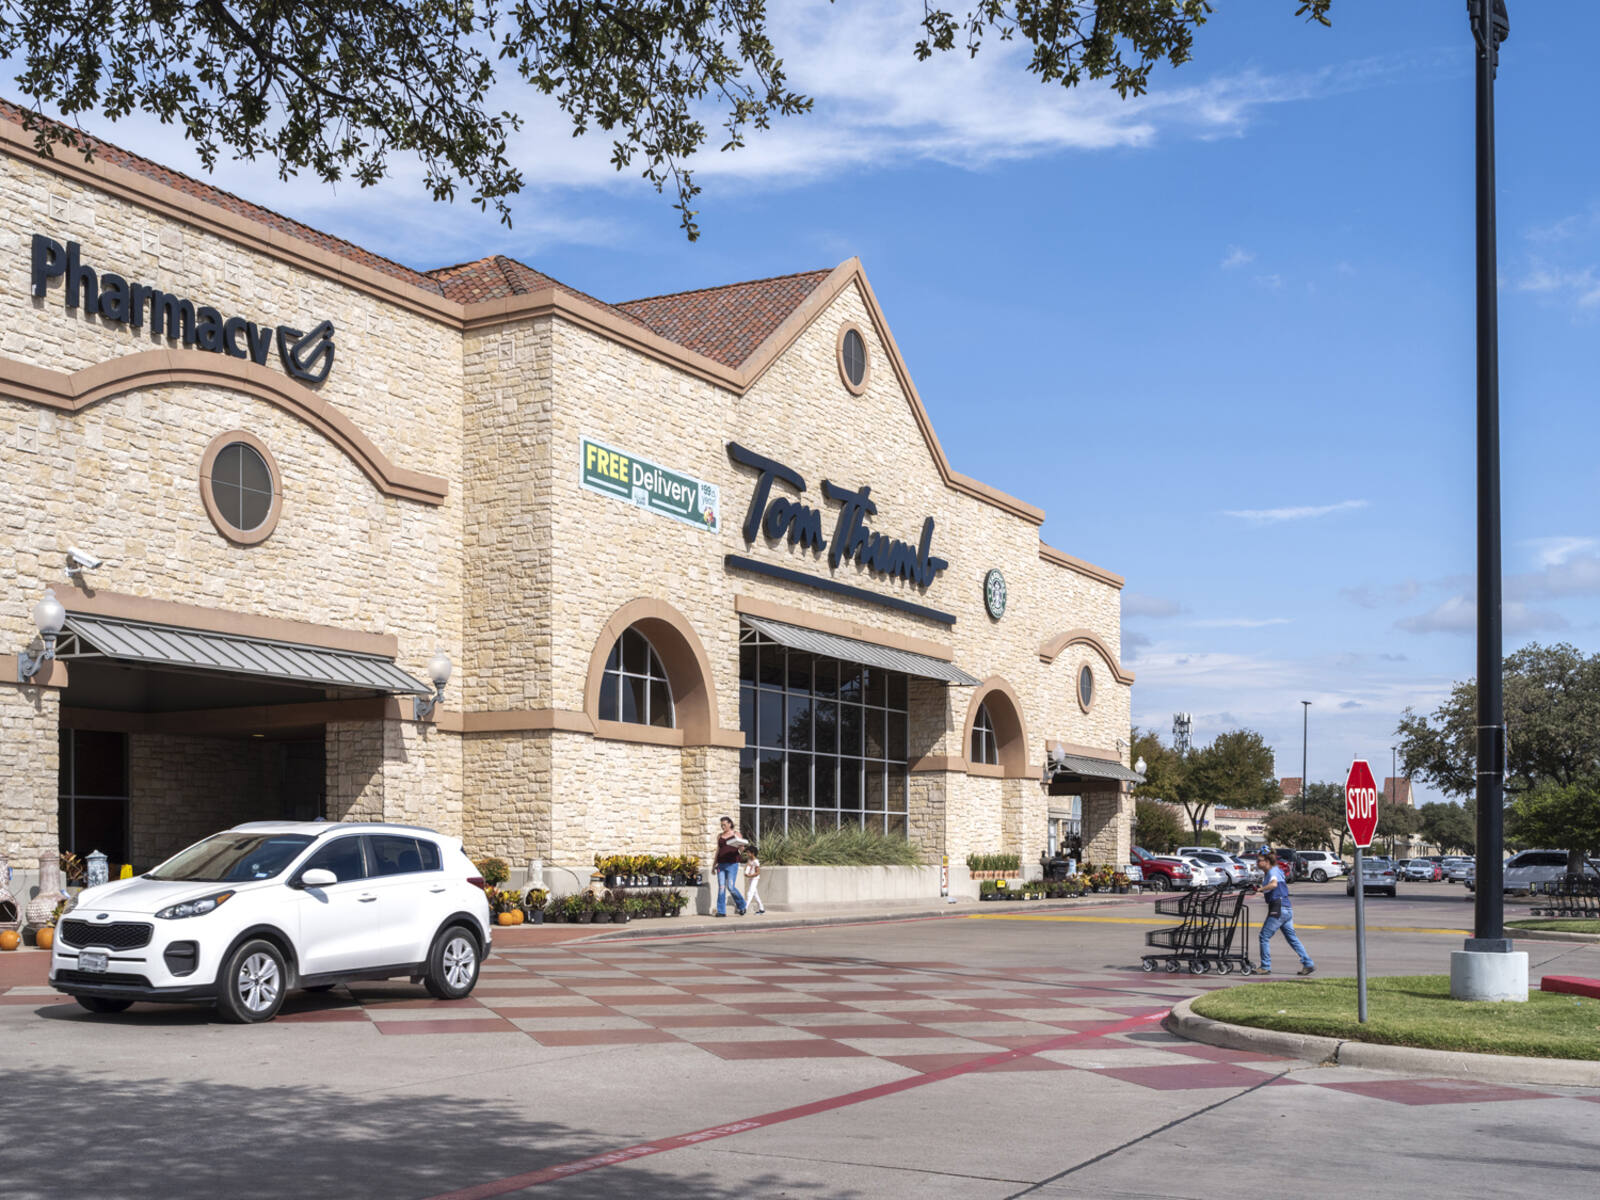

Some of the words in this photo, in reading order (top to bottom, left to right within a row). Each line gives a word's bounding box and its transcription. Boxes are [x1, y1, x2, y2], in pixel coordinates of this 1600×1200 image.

[31, 233, 272, 366] Pharmacy
[586, 444, 629, 483] FREE
[632, 462, 696, 512] Delivery
[726, 441, 827, 551] Tom
[821, 479, 949, 587] Thumb
[1348, 787, 1375, 819] STOP
